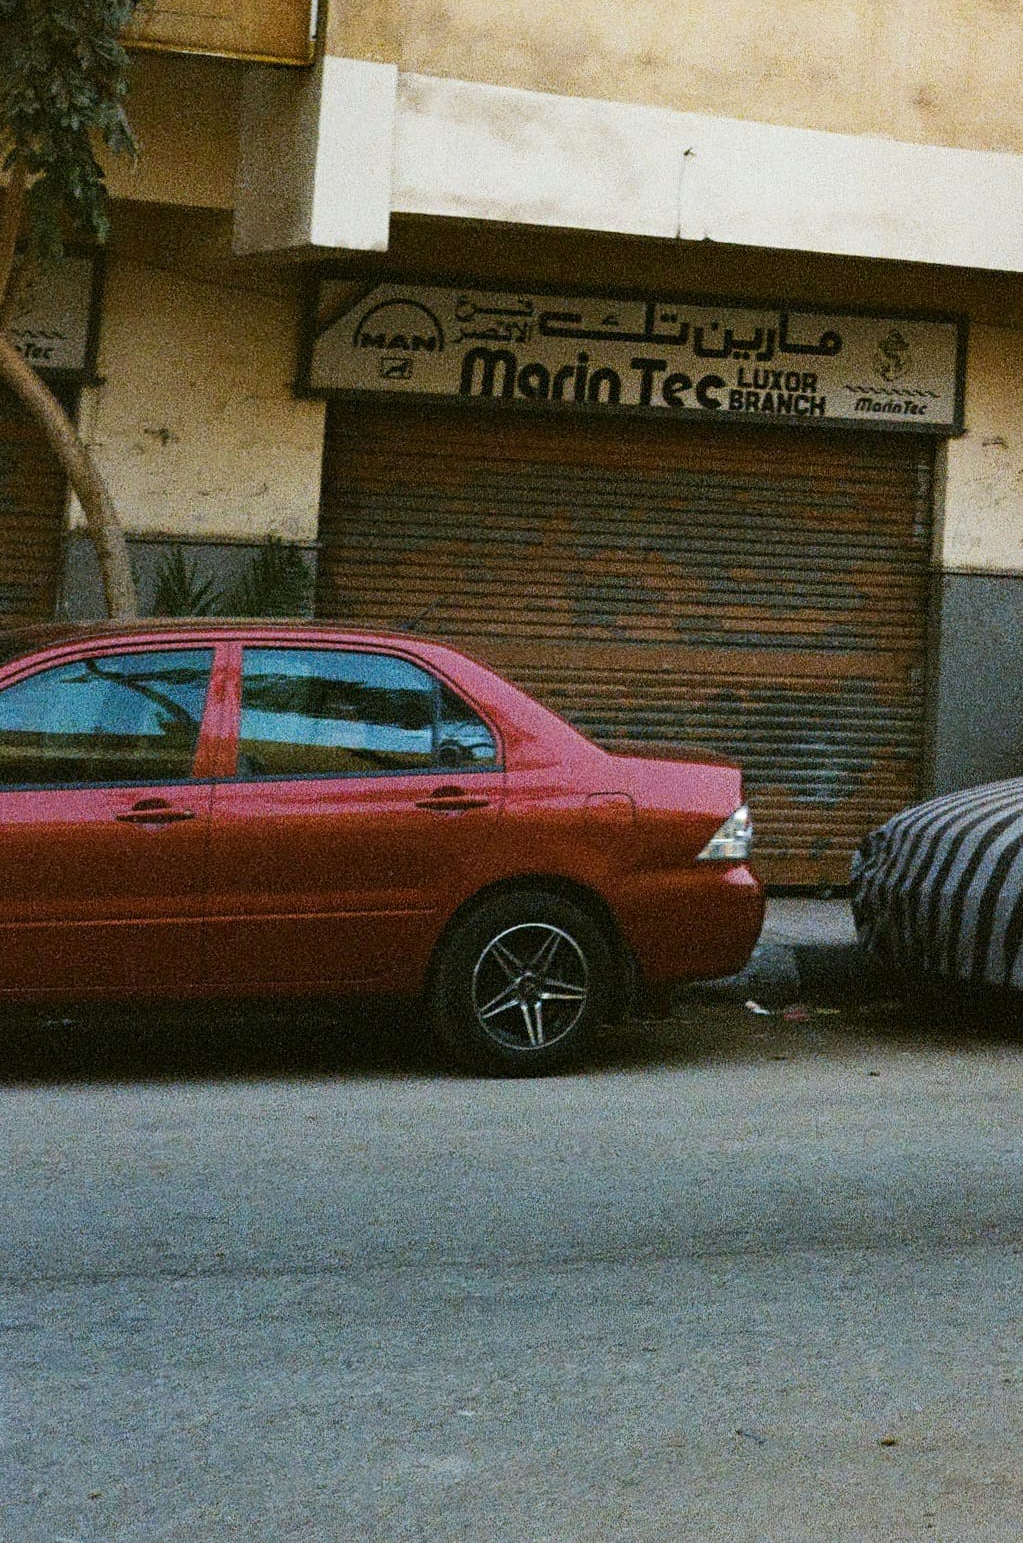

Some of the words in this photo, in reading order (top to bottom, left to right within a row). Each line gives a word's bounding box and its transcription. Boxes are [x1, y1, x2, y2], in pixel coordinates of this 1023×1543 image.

[359, 331, 438, 352] MAN
[693, 309, 844, 362] مارين
[736, 367, 819, 394] LUXOR
[728, 388, 827, 416] BRANCH
